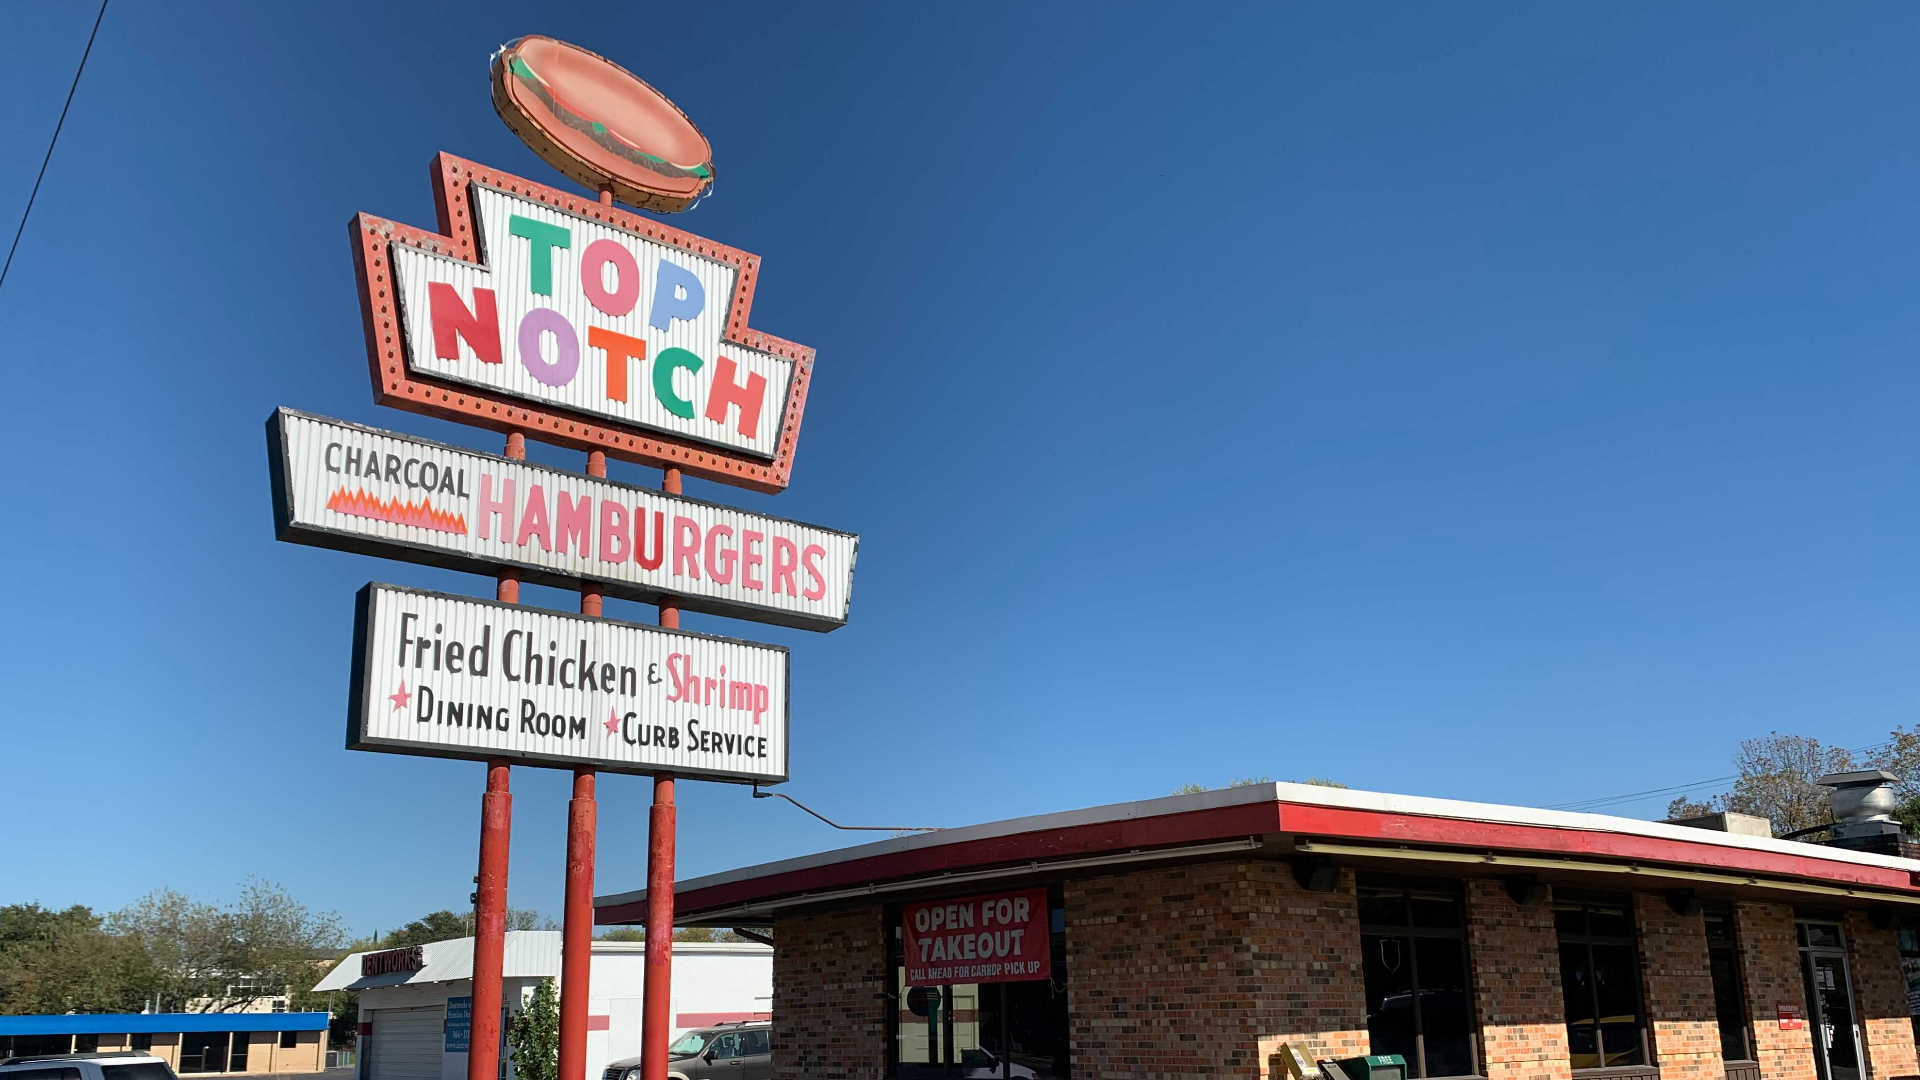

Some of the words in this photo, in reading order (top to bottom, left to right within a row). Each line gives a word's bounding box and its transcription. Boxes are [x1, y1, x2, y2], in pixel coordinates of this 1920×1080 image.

[509, 214, 706, 332] TOP
[428, 281, 767, 439] NOTCH
[324, 441, 470, 499] CHARCOAL
[478, 473, 827, 600] HAMBURGERS
[398, 612, 490, 677] Fried
[501, 628, 638, 697] Chicken
[648, 662, 663, 686] &
[666, 652, 769, 724] Shrimp
[417, 686, 510, 732] DINING
[520, 698, 586, 739] ROOM
[622, 712, 680, 749] CURB
[687, 720, 768, 758] SERVICE
[915, 902, 974, 932] OPEN
[982, 897, 1030, 926] FOR
[362, 946, 418, 976] DENTWORKS
[910, 968, 926, 981] CALL
[928, 967, 952, 980] AHEAD
[954, 965, 969, 978] FOR
[971, 963, 1001, 977] CARHOP
[1004, 961, 1026, 975] PICK
[1027, 960, 1041, 973] UP
[918, 929, 1025, 962] TAKEOUT
